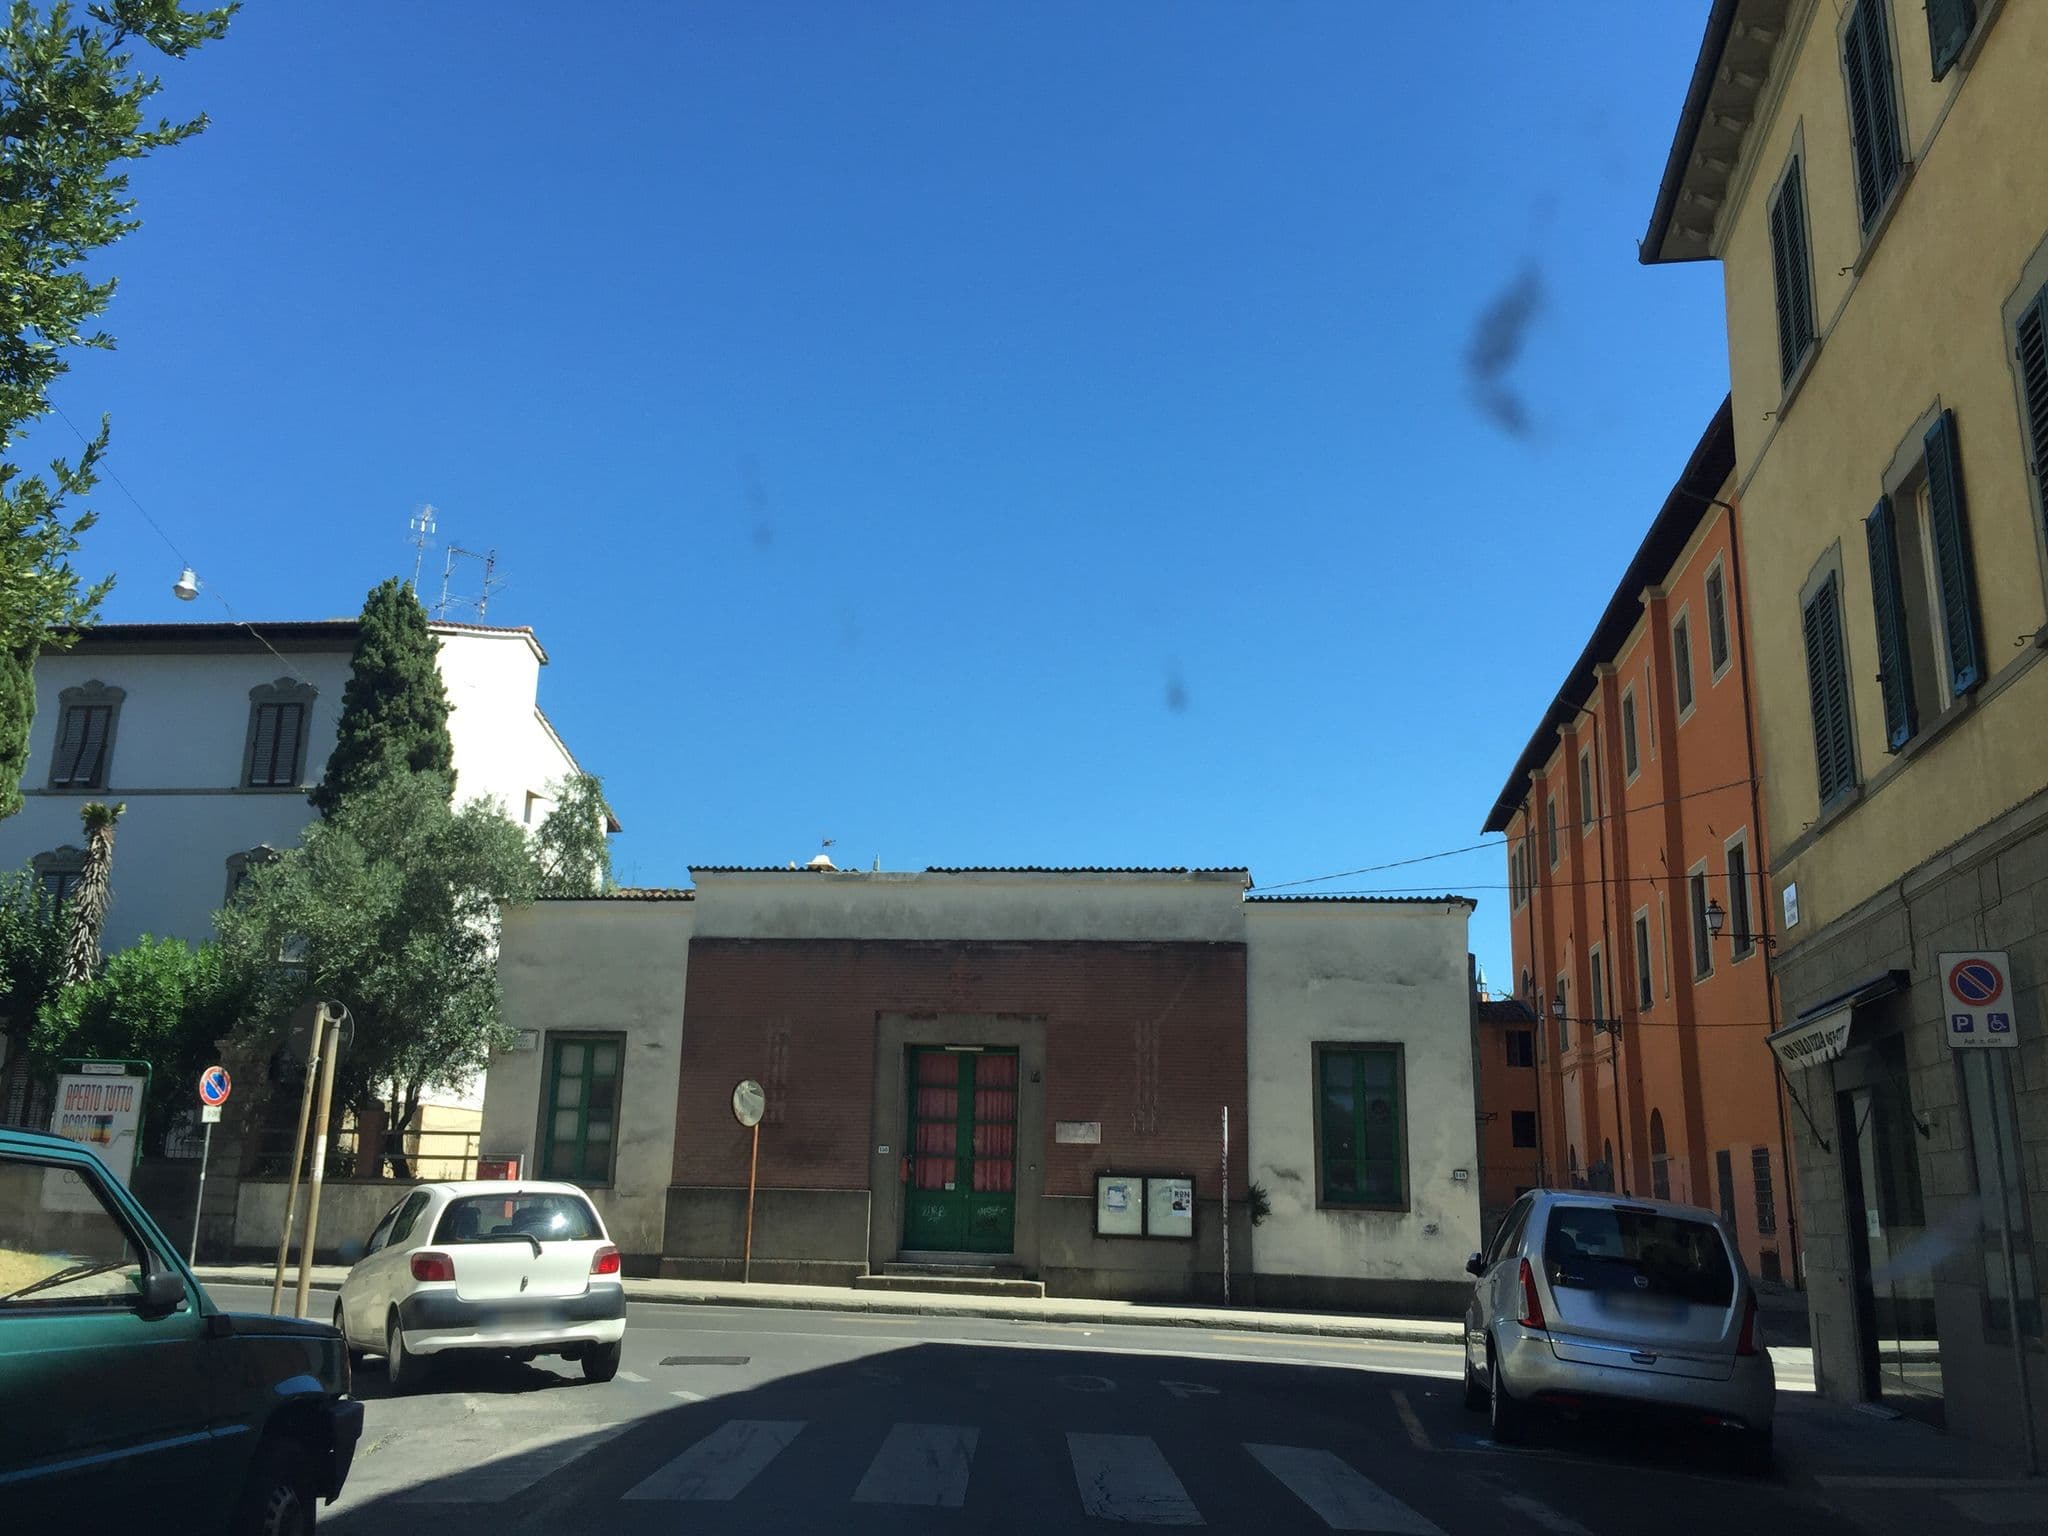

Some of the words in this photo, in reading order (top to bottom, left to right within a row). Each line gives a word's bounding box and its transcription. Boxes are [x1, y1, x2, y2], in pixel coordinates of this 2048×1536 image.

[1956, 1016, 1969, 1031] P
[64, 1083, 103, 1111] APERTO
[103, 1085, 133, 1112] TUTTO
